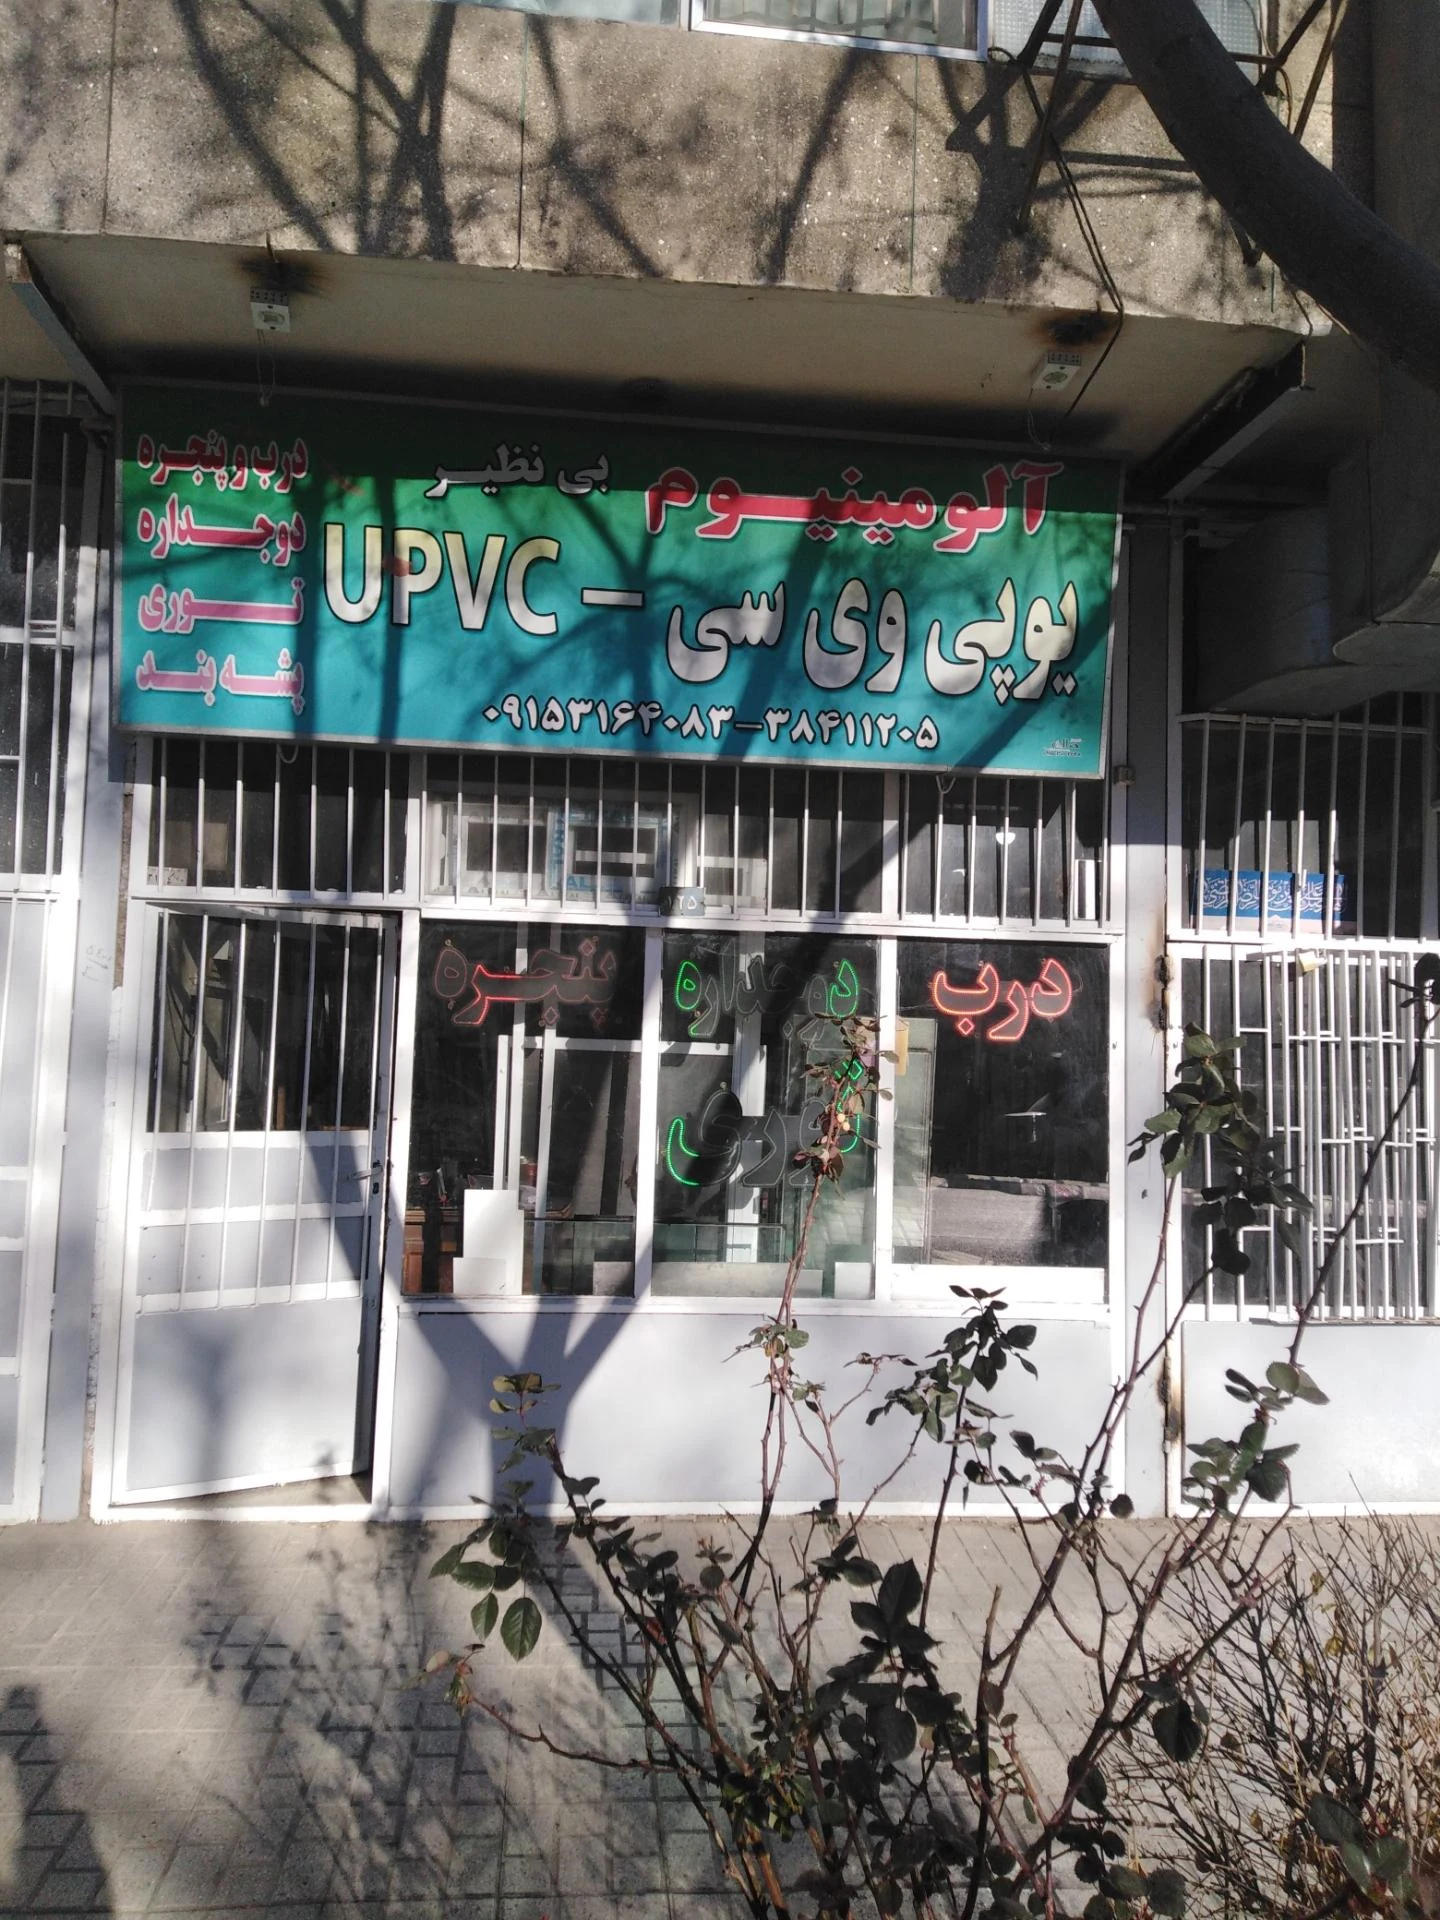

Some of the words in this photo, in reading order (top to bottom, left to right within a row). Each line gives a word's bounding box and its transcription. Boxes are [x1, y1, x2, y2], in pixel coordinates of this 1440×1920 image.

[138, 430, 228, 491] پنجره
[252, 438, 308, 493] درب
[424, 442, 546, 499] نظیر
[556, 454, 611, 496] بی
[645, 459, 1065, 553] آلومینیوم
[138, 576, 305, 635] توری
[323, 522, 561, 636] UPVC
[666, 580, 786, 683] سی
[136, 650, 216, 707] بند
[219, 648, 305, 716] پشه
[934, 958, 1073, 1041] درب
